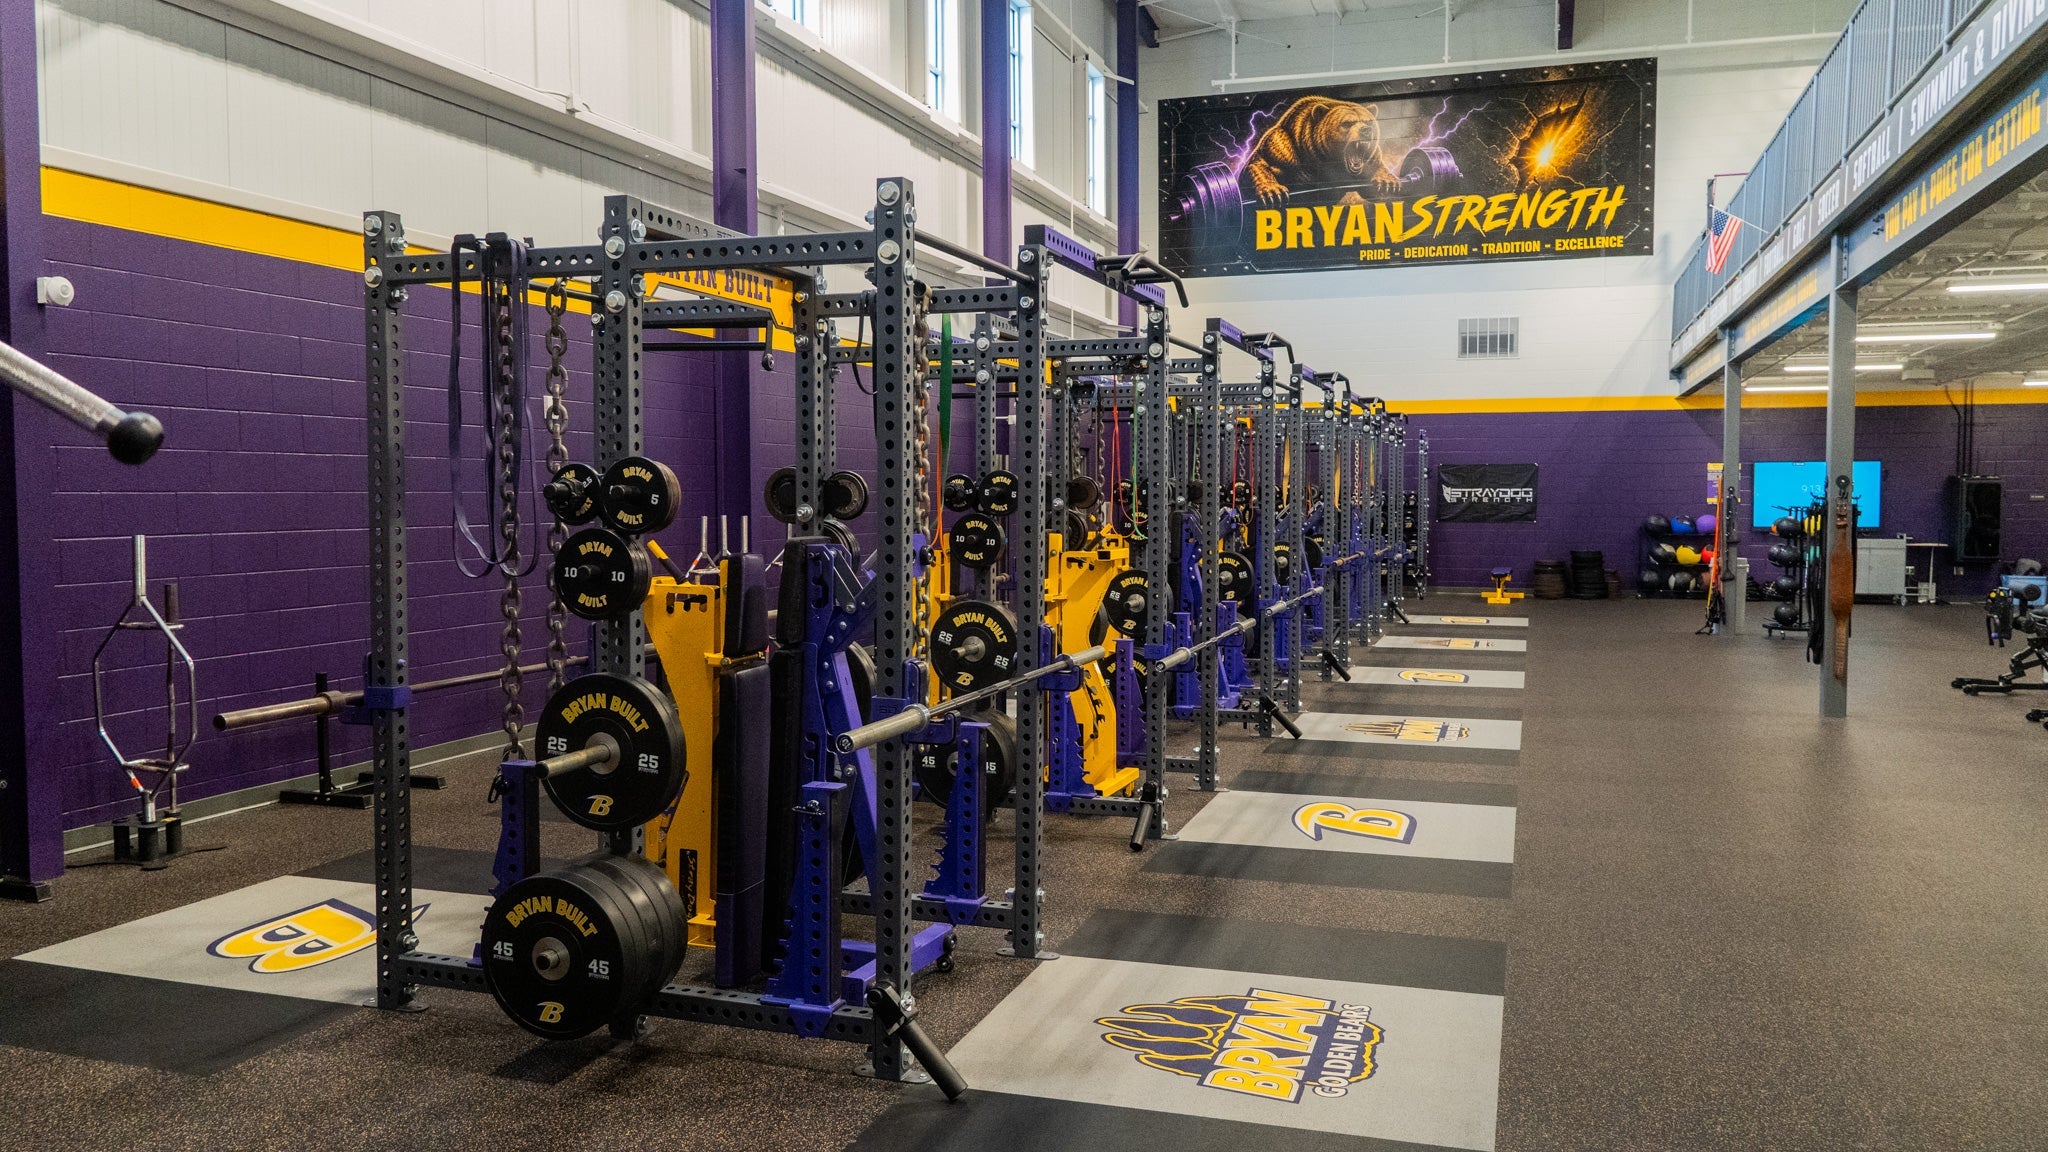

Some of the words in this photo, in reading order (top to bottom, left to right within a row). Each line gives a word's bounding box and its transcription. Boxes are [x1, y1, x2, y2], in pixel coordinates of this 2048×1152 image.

[1910, 45, 1969, 136] SWIMMING
[1973, 29, 1985, 76] &
[1852, 126, 1891, 192] SOFTBALL
[1885, 202, 1900, 243] YOU
[1902, 187, 1919, 230] PAY
[1920, 180, 1927, 217] A
[1930, 155, 1958, 209] PRICE
[1961, 135, 1983, 186] FOR
[1987, 88, 2041, 167] GETTING
[1256, 200, 1404, 250] BRYAN
[1397, 185, 1628, 243] STRENGTH
[1359, 248, 1391, 261] PRIDE
[1404, 244, 1468, 259] DEDICATION
[1481, 240, 1541, 254] TRADITION
[1555, 235, 1624, 250] EXCELLENCE
[725, 268, 774, 303] BUILT
[623, 466, 653, 483] BRYAN
[992, 475, 1012, 485] BRYAN
[650, 494, 660, 505] 5
[1450, 487, 1533, 498] STRAYDOG
[616, 509, 643, 525] BUILT
[966, 520, 988, 531] BRYAN
[578, 541, 613, 558] BRYAN
[986, 538, 995, 546] 10
[964, 550, 984, 560] BUILT
[564, 567, 578, 578] 10
[611, 571, 625, 582] 10
[578, 592, 608, 608] BUILT
[953, 612, 985, 627] BRYAN
[985, 617, 1008, 643] BUILT
[938, 631, 953, 642] 25
[994, 655, 1010, 667] 25
[956, 671, 974, 686] B
[561, 693, 607, 724] BRYAN
[609, 695, 649, 733] BUILT
[547, 736, 568, 751] 25
[638, 753, 659, 769] 25
[922, 755, 936, 765] 45
[586, 794, 614, 816] B
[506, 896, 552, 928] BRYAN
[556, 899, 598, 938] BUILT
[493, 940, 514, 957] 45
[588, 958, 610, 975] 45
[537, 1001, 565, 1023] B
[1334, 1003, 1372, 1042] BEARS
[1201, 987, 1333, 1103] BRYAN
[1313, 1041, 1358, 1098] GOLDEN
